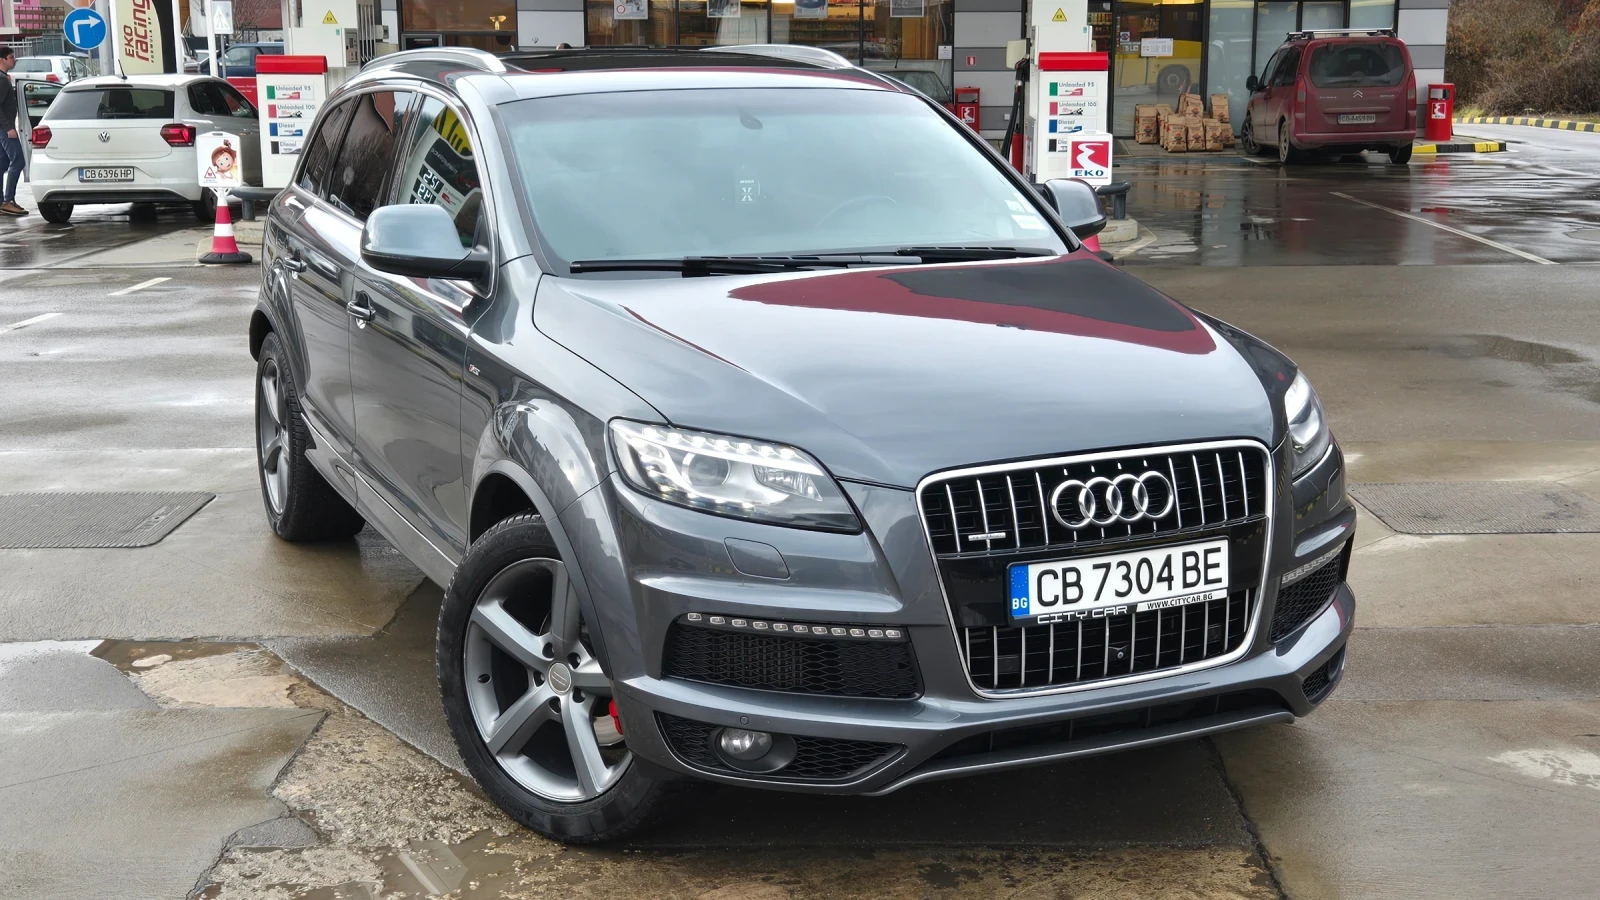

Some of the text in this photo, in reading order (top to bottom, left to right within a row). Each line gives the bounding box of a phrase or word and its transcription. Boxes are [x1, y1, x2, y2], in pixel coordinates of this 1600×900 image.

[132, 0, 150, 62] racing
[124, 24, 134, 58] EKO
[85, 170, 96, 178] CB
[98, 170, 118, 178] 6396
[120, 169, 131, 178] HP
[1037, 546, 1222, 607] CB 7304 BE
[1012, 597, 1028, 609] BG
[1147, 593, 1213, 610] WWW.CITYCAR.BG
[1038, 606, 1128, 624] CITY CAR
